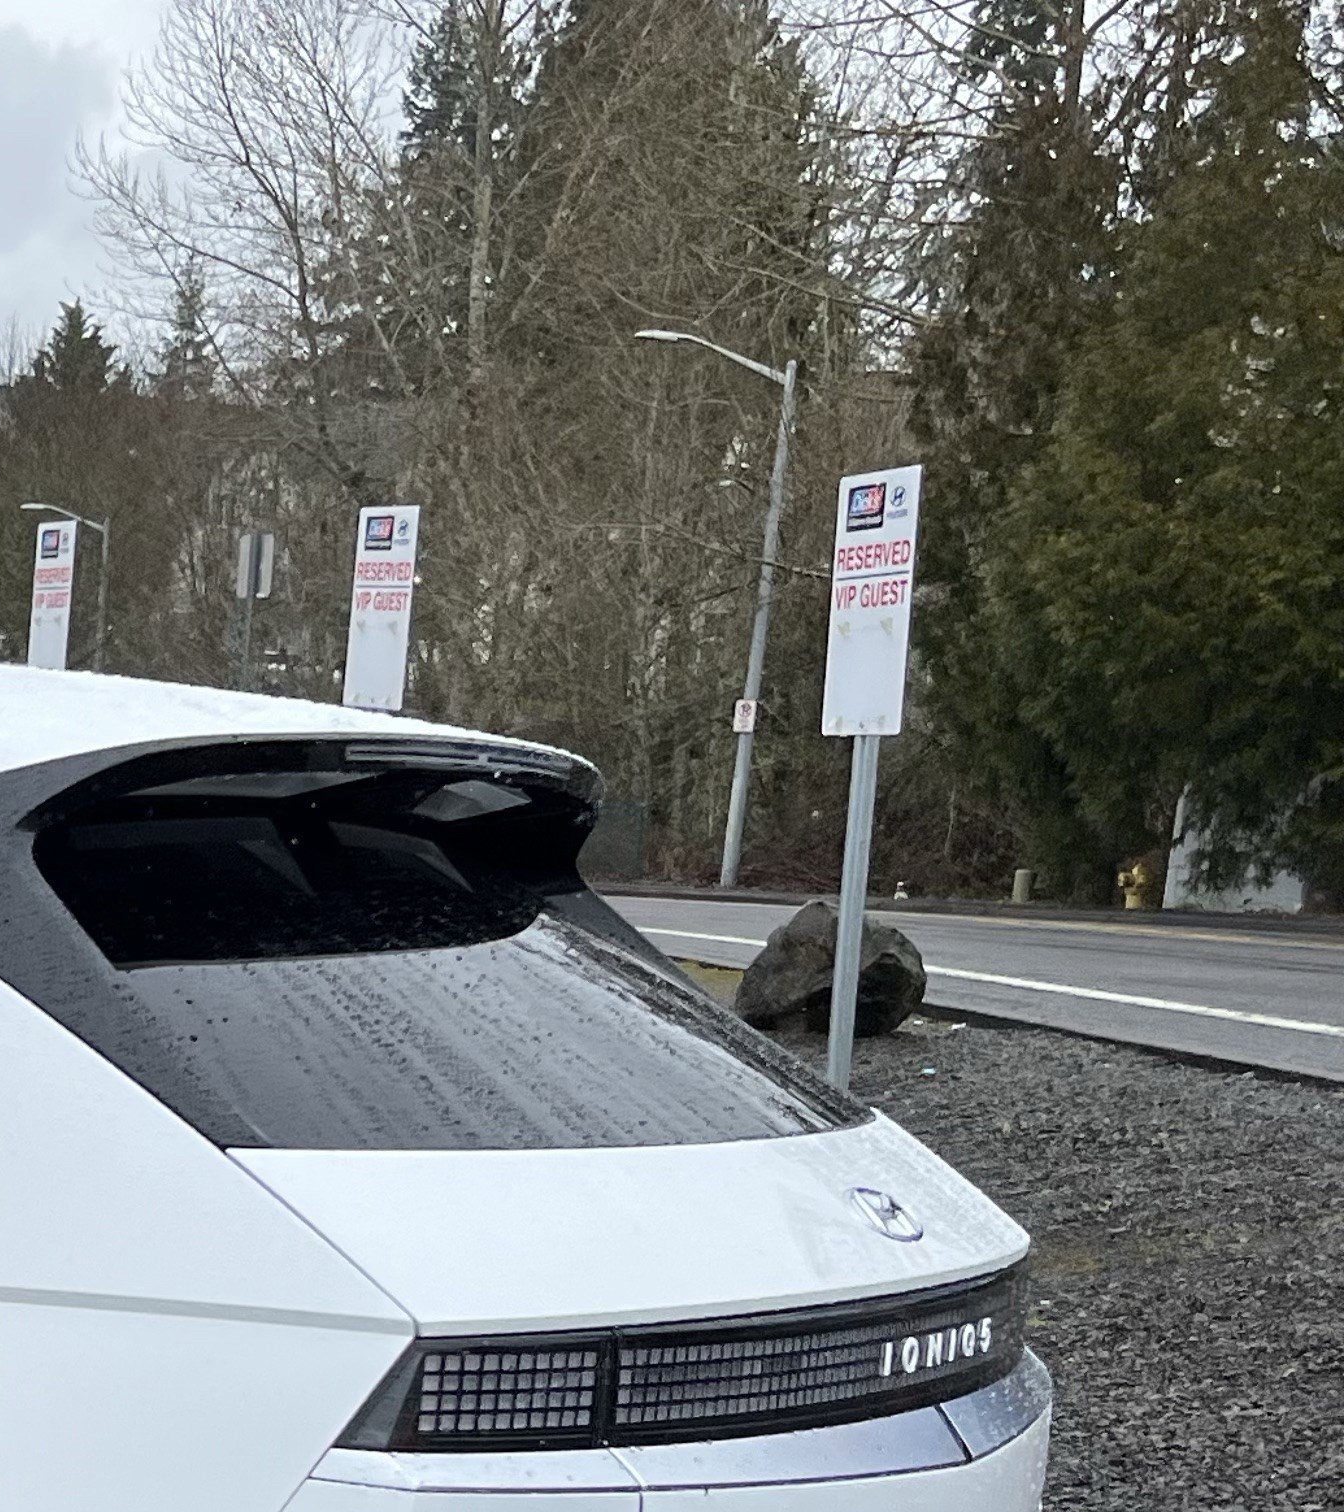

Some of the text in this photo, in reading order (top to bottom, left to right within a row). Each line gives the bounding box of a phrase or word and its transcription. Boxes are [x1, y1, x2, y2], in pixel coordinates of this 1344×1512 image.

[836, 540, 911, 572] RESERVED
[357, 562, 411, 581] RESERVED
[373, 591, 409, 611] GUEST
[836, 579, 909, 611] VIP GUEST
